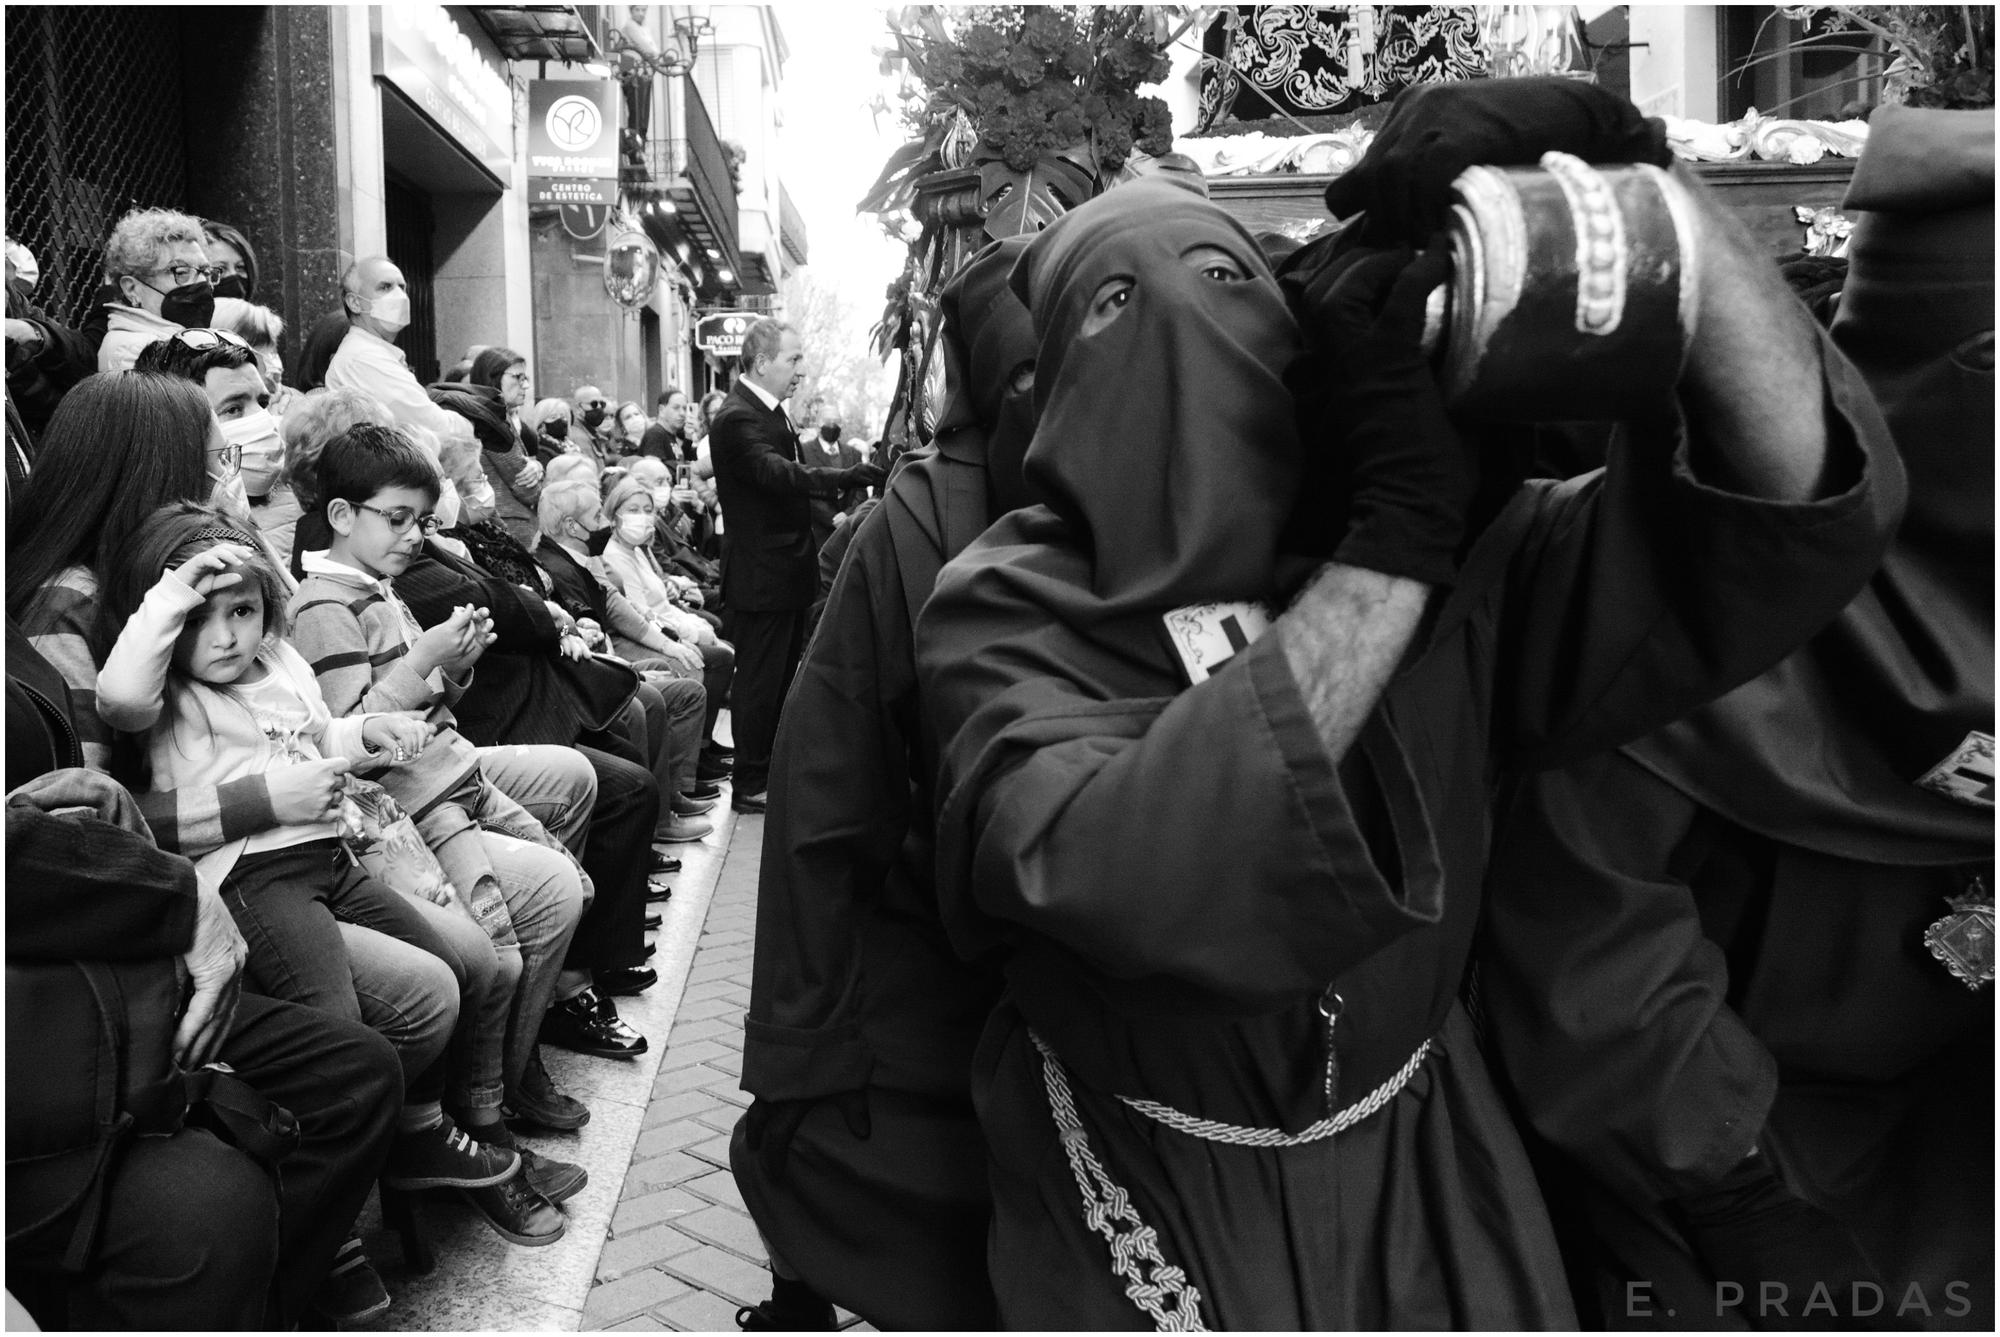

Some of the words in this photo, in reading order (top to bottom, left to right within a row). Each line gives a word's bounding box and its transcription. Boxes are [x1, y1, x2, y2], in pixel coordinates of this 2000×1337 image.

[551, 183, 591, 192] CENTRO
[539, 191, 552, 200] DE
[706, 335, 735, 346] PACO
